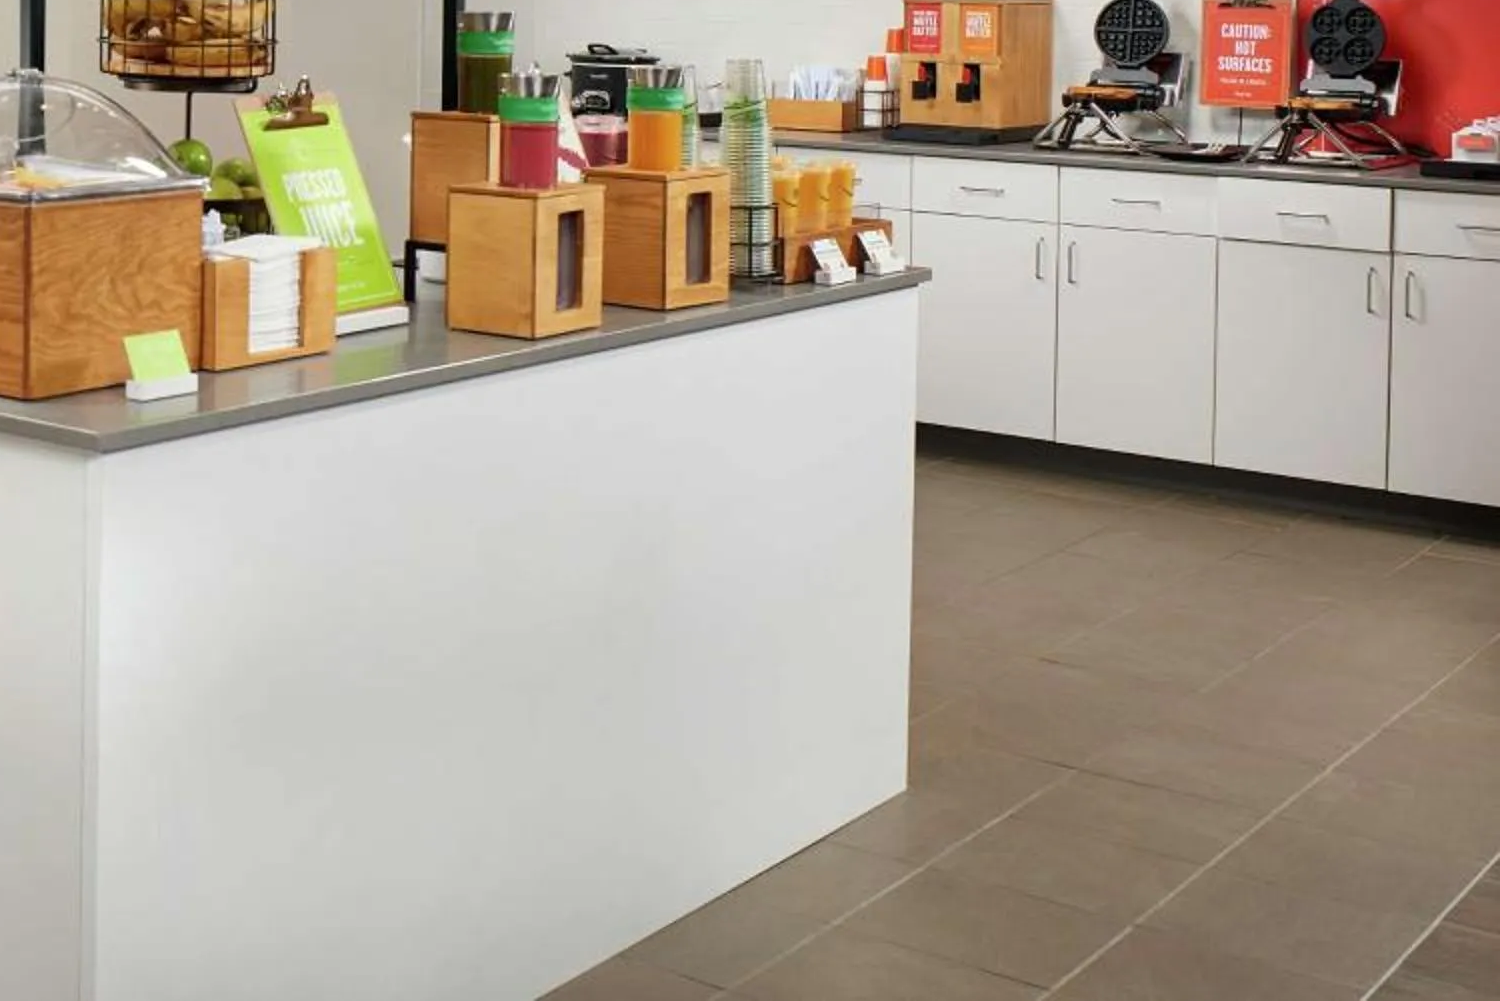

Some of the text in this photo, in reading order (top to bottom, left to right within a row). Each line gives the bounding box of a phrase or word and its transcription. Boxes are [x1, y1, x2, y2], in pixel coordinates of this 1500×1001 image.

[1235, 40, 1257, 56] HOT
[1218, 55, 1273, 74] SURFACES
[283, 168, 347, 204] PRESSED
[300, 200, 364, 248] JUICE
